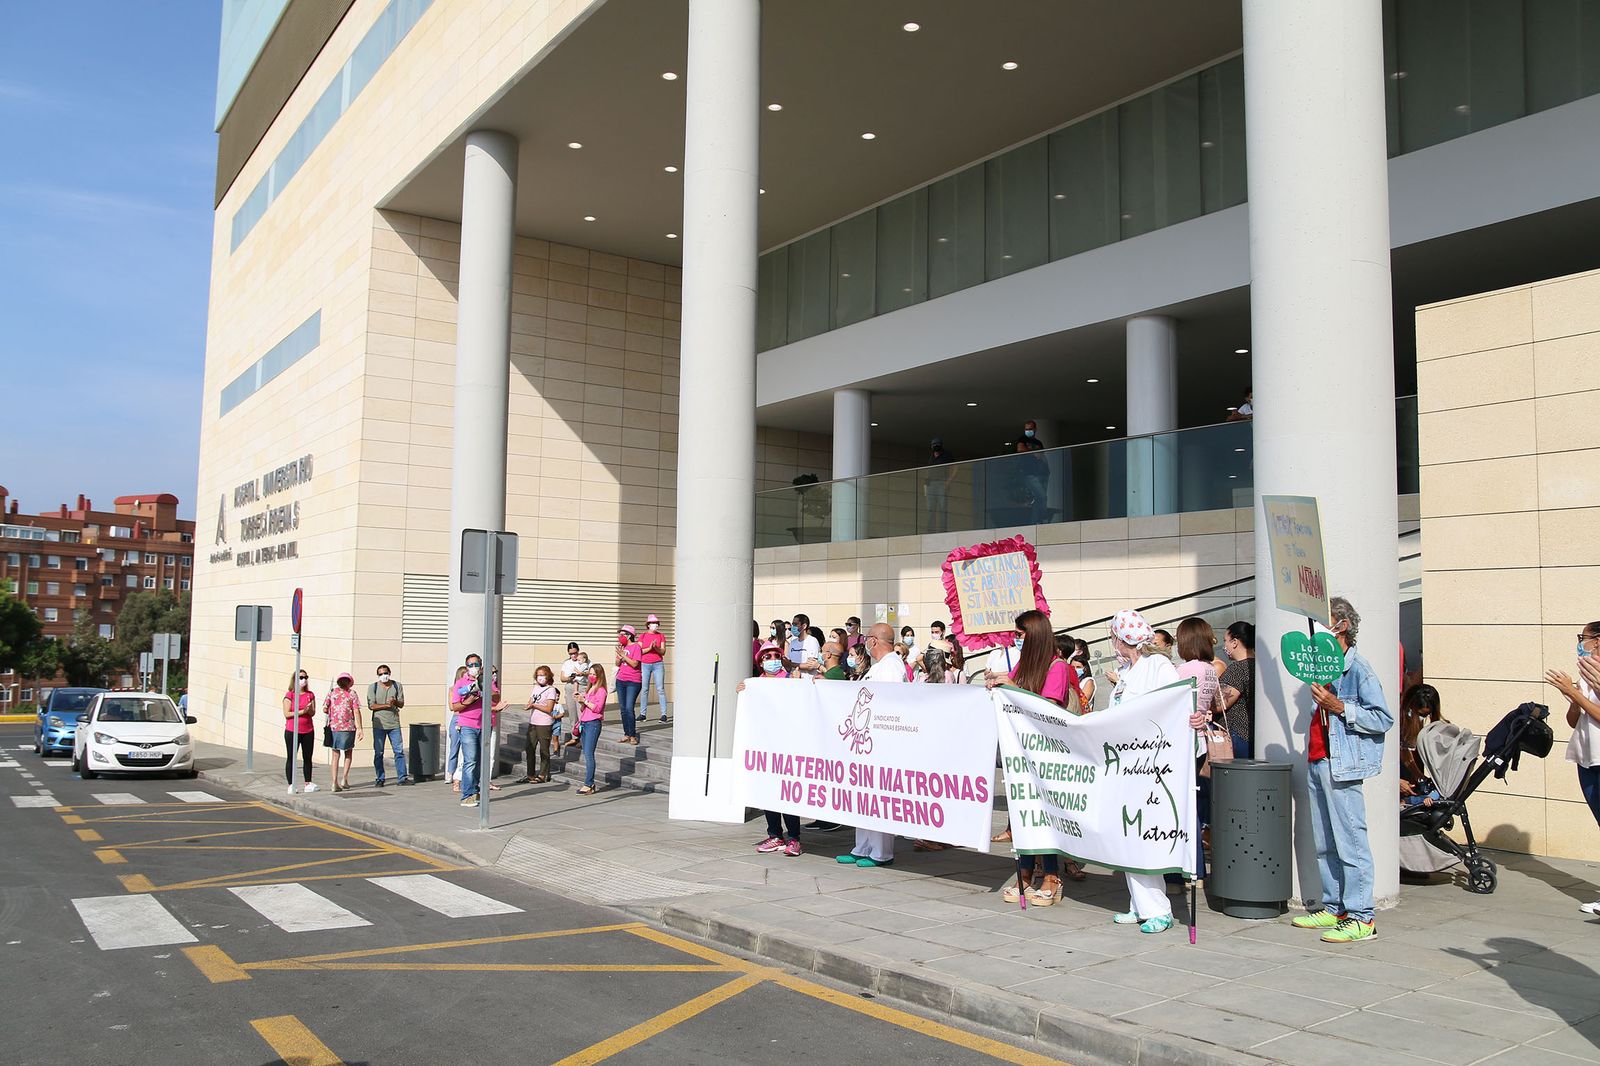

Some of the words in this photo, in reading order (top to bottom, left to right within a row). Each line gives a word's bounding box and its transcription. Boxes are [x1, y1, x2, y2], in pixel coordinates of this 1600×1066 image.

[234, 478, 260, 508] HOSPITL
[263, 453, 313, 498] UNIVERSITRIO
[1289, 651, 1339, 663] SERVICIOS
[1301, 644, 1319, 652] LOS
[1017, 732, 1070, 754] UCHAMOS
[744, 750, 767, 772] UN
[772, 753, 845, 784] MATERNO
[849, 762, 874, 789] SIN
[879, 766, 989, 803] MATRONAS
[1005, 757, 1029, 773] POR
[1040, 762, 1096, 784] DERECHOS
[1011, 783, 1024, 800] DE
[1147, 791, 1160, 805] de
[781, 780, 802, 804] NO
[807, 784, 827, 808] ES
[832, 788, 852, 812] UN
[857, 792, 945, 828] MATERNO
[1020, 810, 1028, 827] Y
